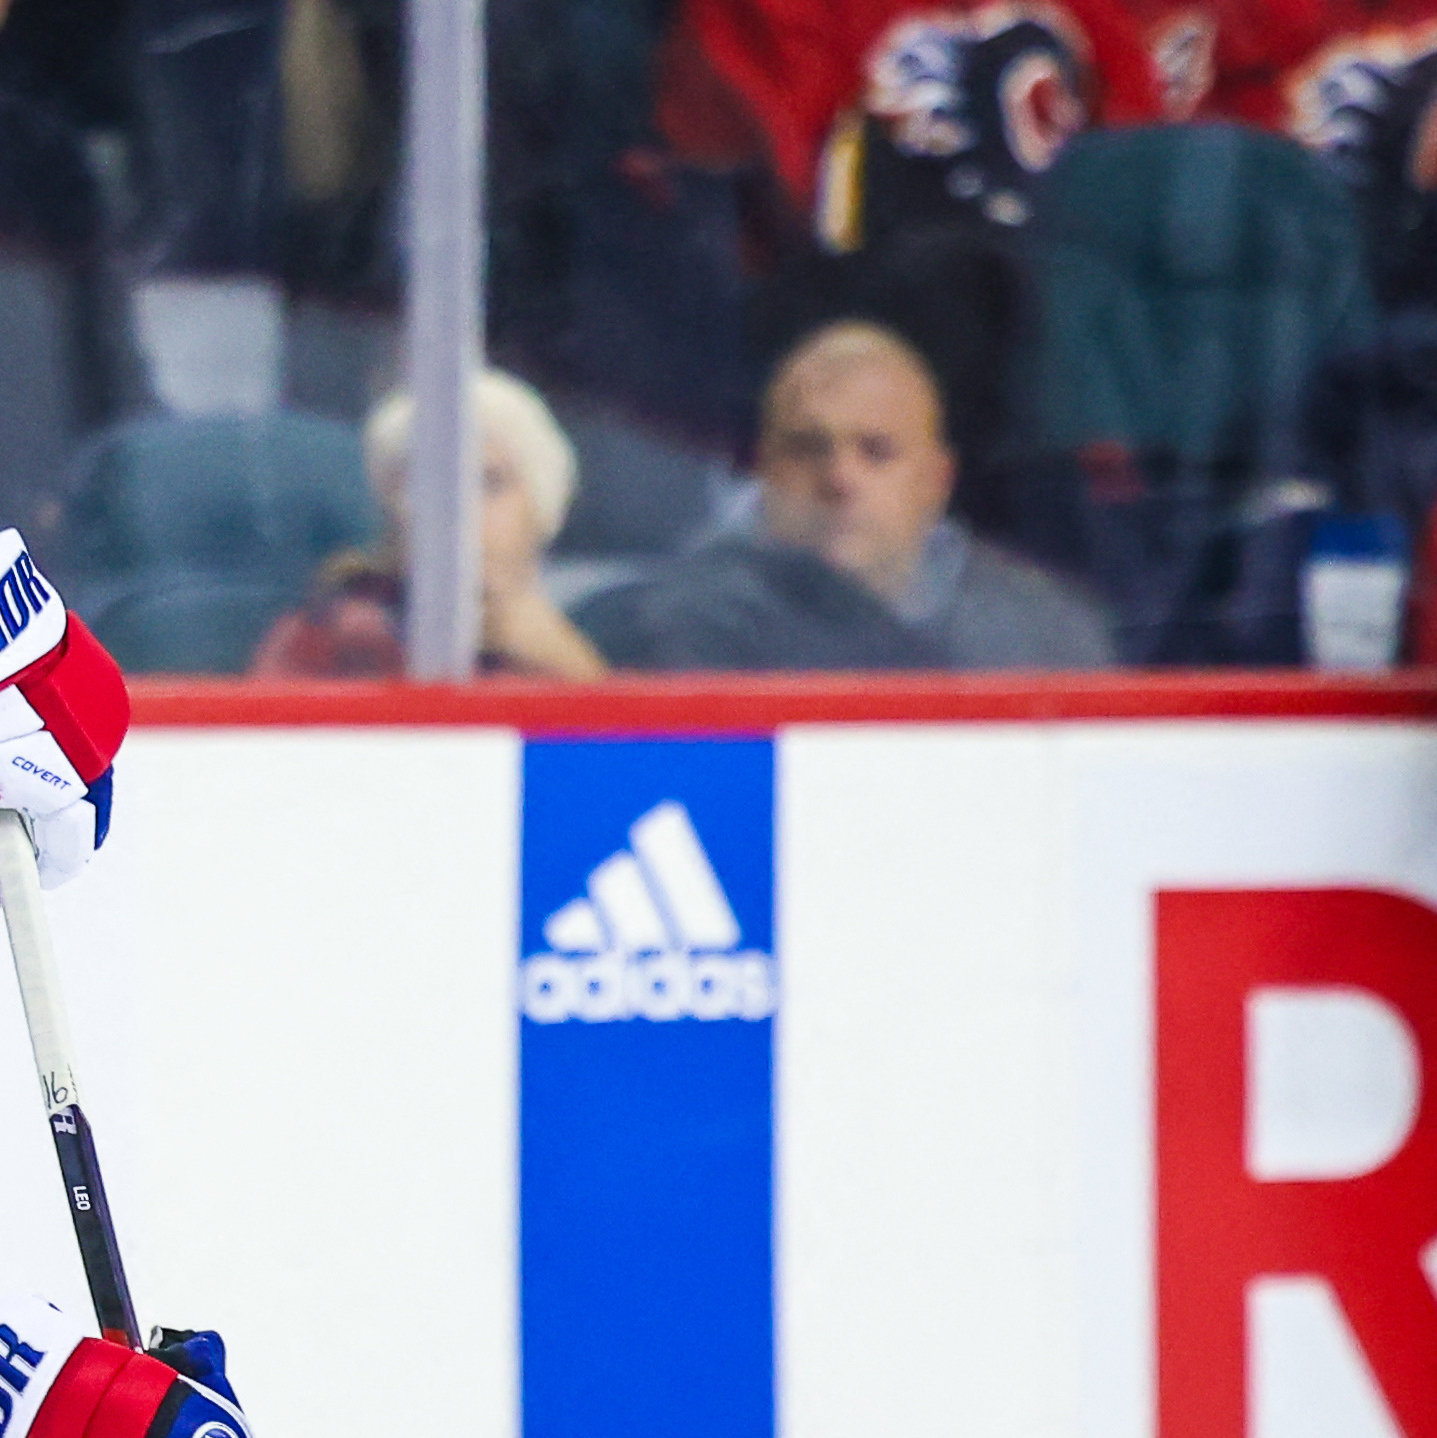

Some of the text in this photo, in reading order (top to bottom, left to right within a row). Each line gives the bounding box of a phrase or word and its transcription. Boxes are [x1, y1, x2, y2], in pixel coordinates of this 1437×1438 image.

[11, 756, 72, 790] COVERT
[521, 947, 777, 1024] adidas
[42, 1071, 68, 1109] 16
[73, 1185, 91, 1211] LEO
